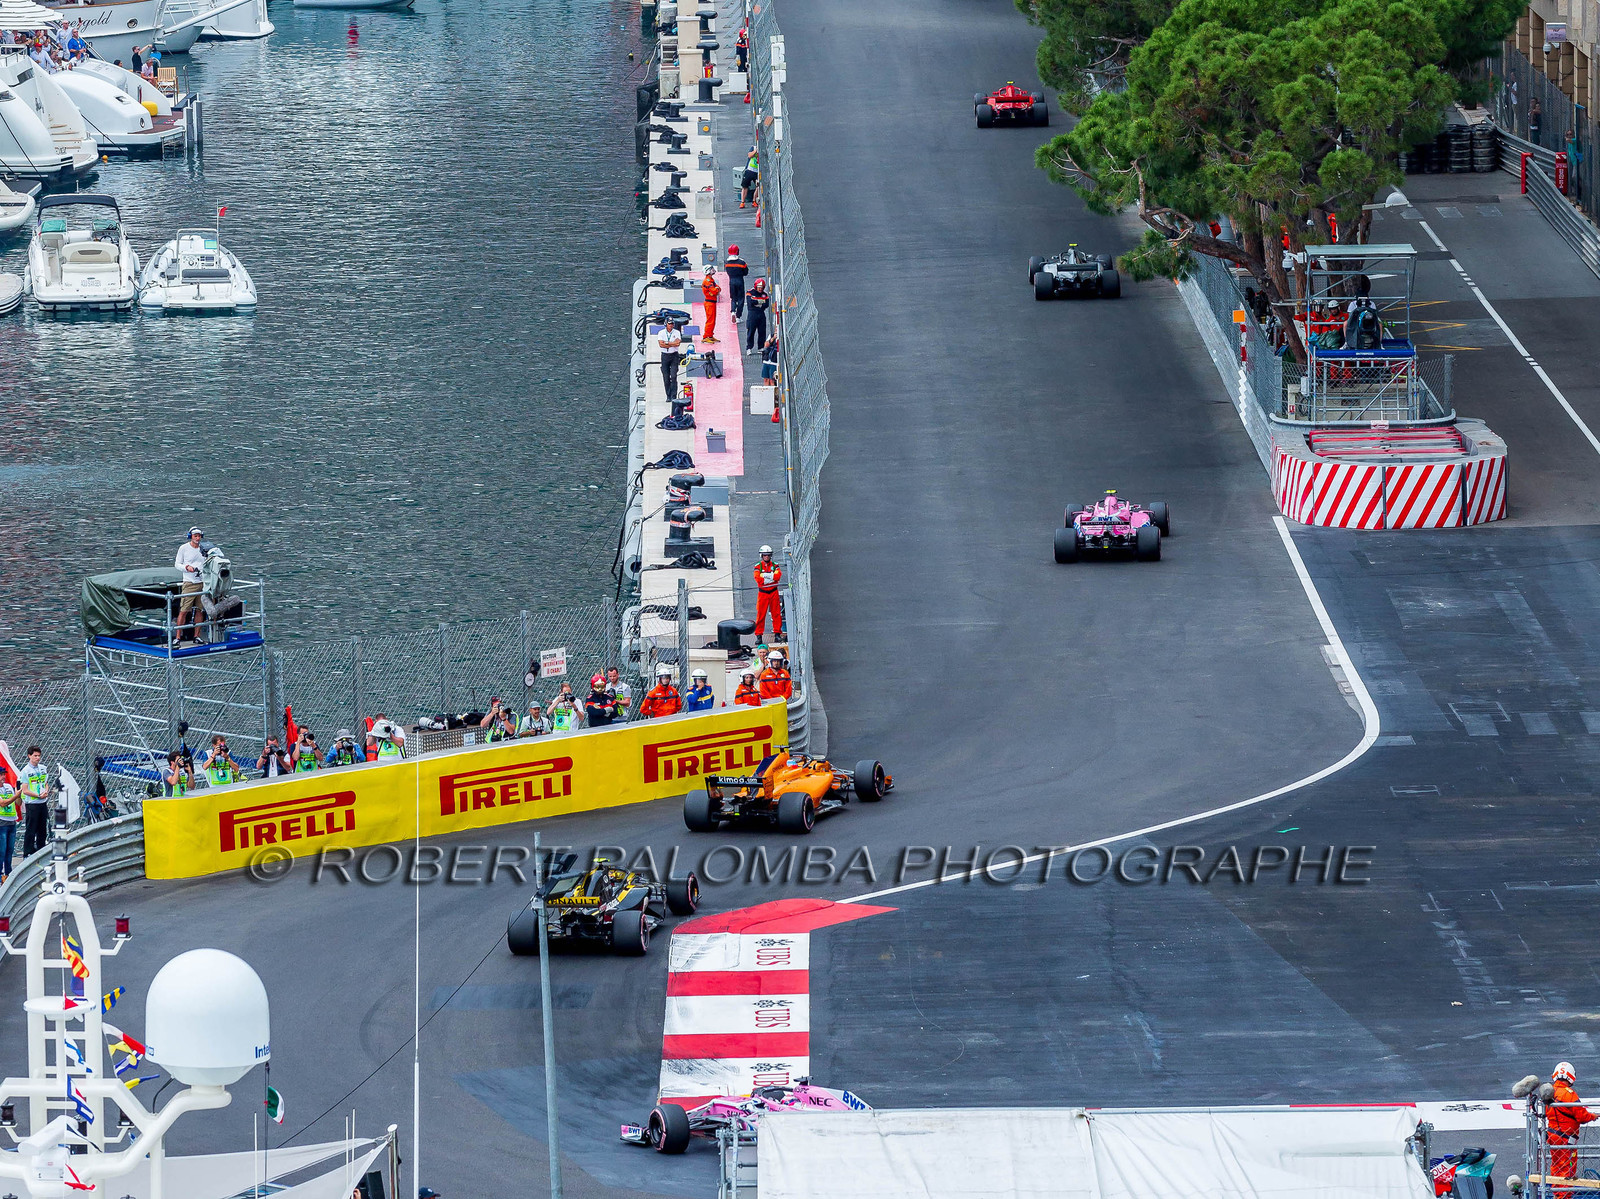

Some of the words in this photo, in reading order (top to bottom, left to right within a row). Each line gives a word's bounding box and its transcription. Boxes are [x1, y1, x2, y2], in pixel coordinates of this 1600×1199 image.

[643, 724, 774, 784] PIRELLI
[439, 756, 573, 816] PIRELLI
[219, 790, 356, 852] PIRELLI
[756, 947, 791, 966] UBS
[755, 1008, 790, 1028] UBS
[753, 1072, 790, 1087] UB
[809, 1096, 833, 1108] NEC
[628, 1127, 641, 1135] BWT
[1431, 1163, 1449, 1177] OLA
